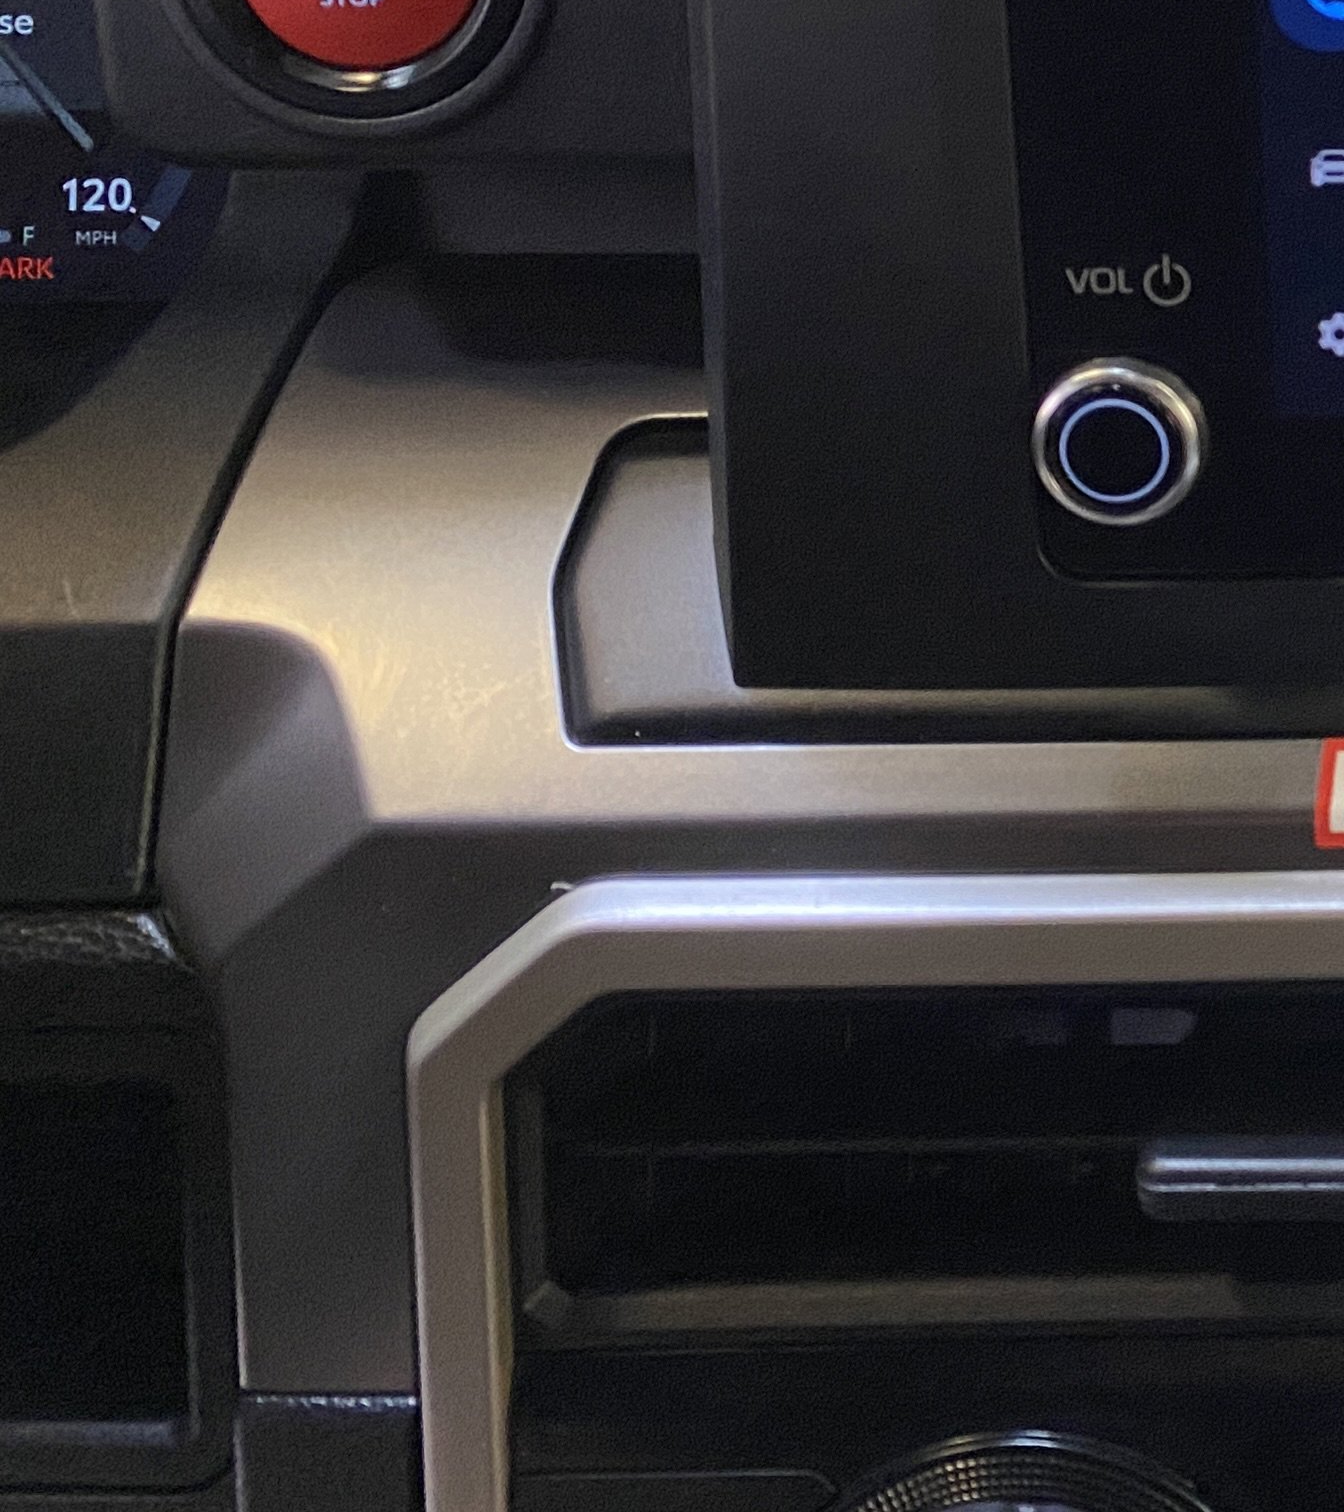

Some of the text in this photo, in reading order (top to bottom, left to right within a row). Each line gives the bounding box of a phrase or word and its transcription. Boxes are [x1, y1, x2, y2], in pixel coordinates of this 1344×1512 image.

[62, 177, 132, 211] 120
[22, 226, 36, 246] F
[75, 230, 118, 245] MPH
[1065, 268, 1134, 295] VOL
